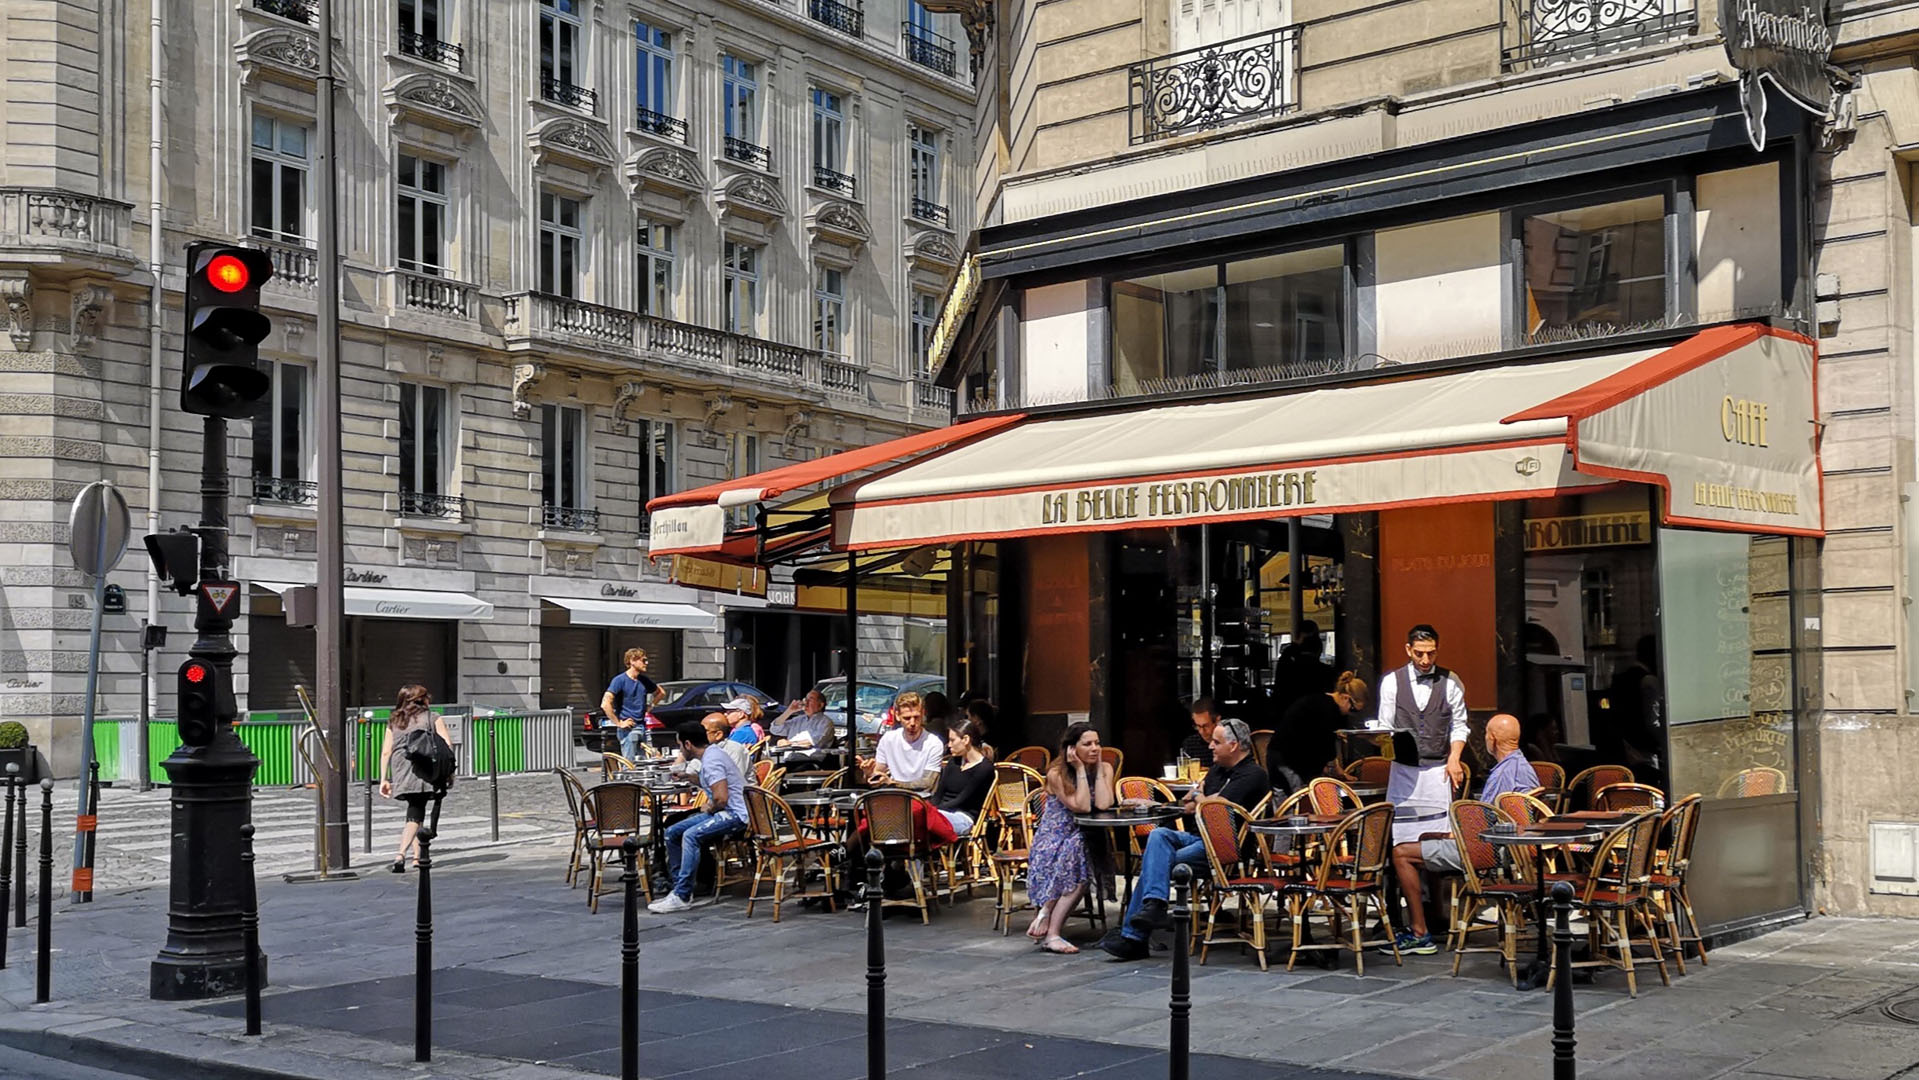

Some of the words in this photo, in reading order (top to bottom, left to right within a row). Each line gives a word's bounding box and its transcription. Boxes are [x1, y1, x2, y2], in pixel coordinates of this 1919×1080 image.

[1042, 493, 1068, 524] LA
[1076, 486, 1139, 521] BELLE
[1148, 470, 1317, 517] FERRONNIERE
[343, 567, 387, 583] Cartier
[601, 583, 638, 597] Cartier
[375, 600, 411, 614] Cartier
[633, 614, 660, 625] Cartier
[6, 679, 44, 689] Cartier
